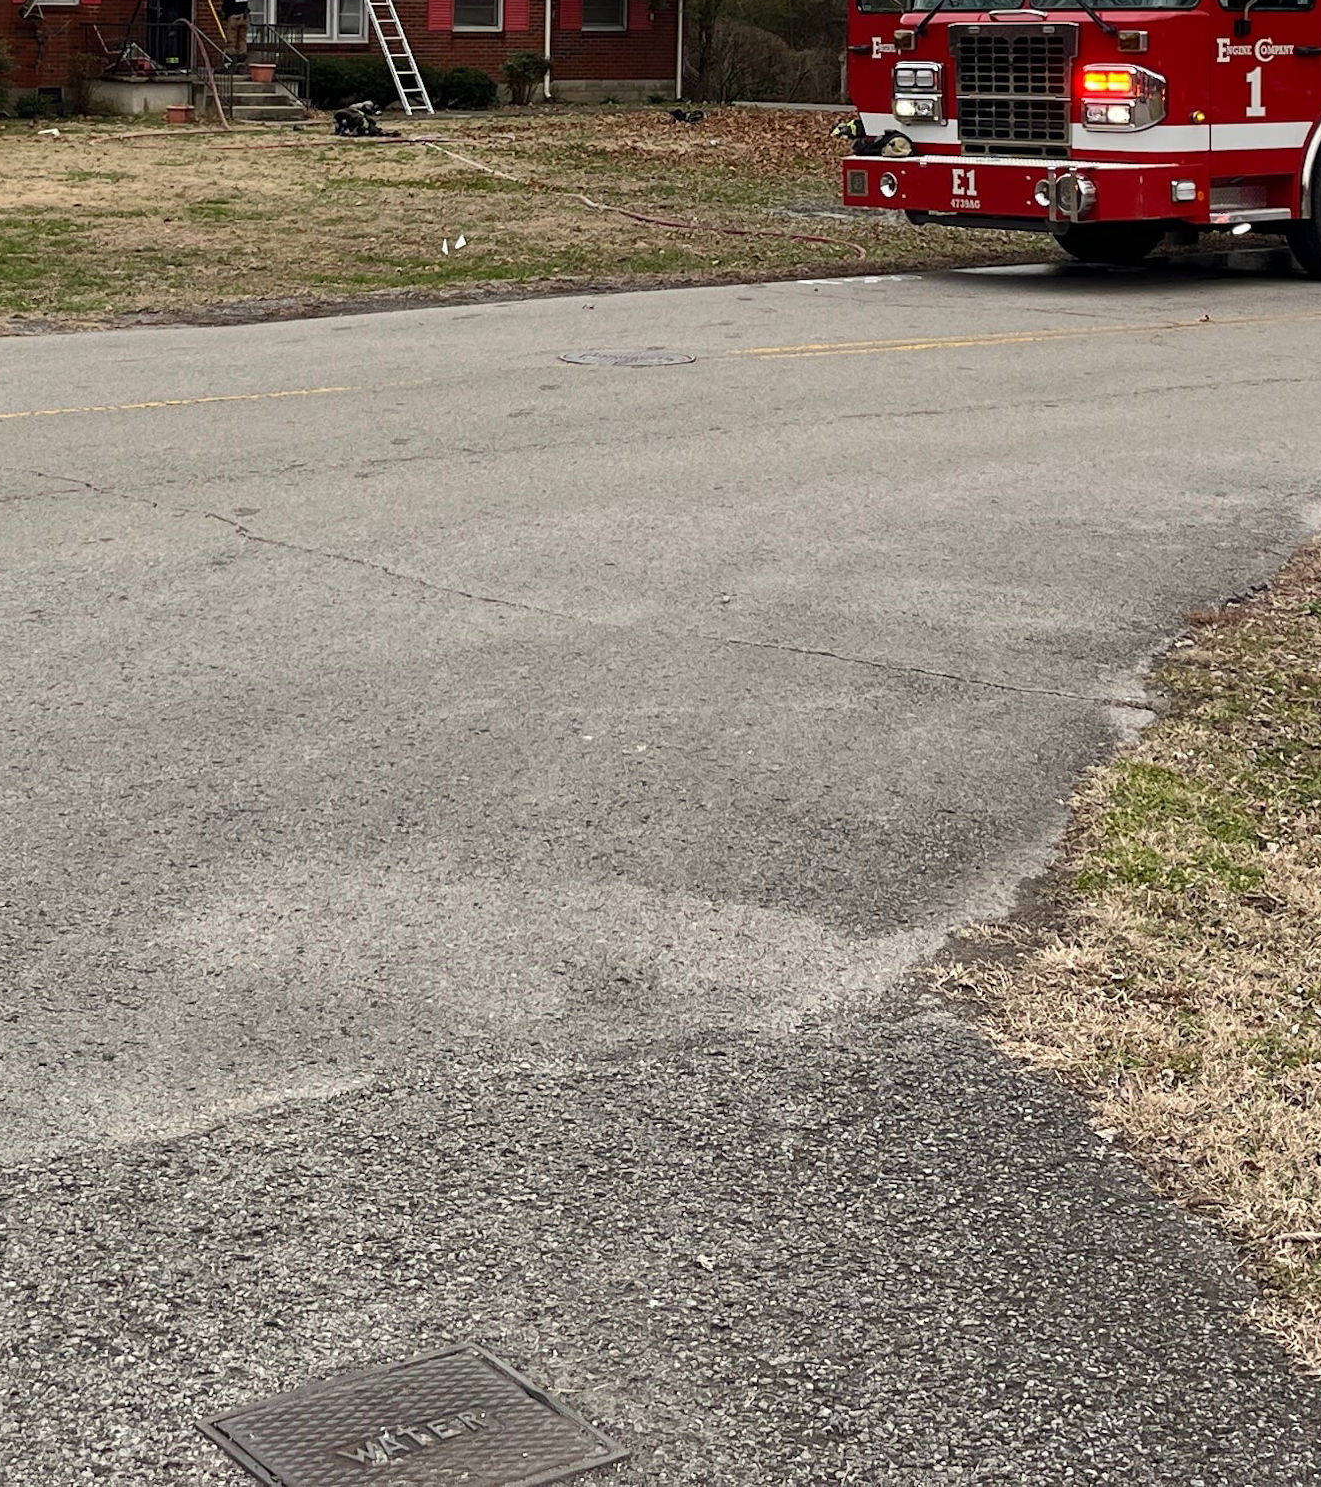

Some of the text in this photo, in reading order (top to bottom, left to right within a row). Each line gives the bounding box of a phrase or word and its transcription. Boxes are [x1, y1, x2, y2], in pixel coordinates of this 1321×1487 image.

[1246, 66, 1266, 117] 1
[952, 169, 977, 196] E1
[337, 1410, 488, 1464] WATER
